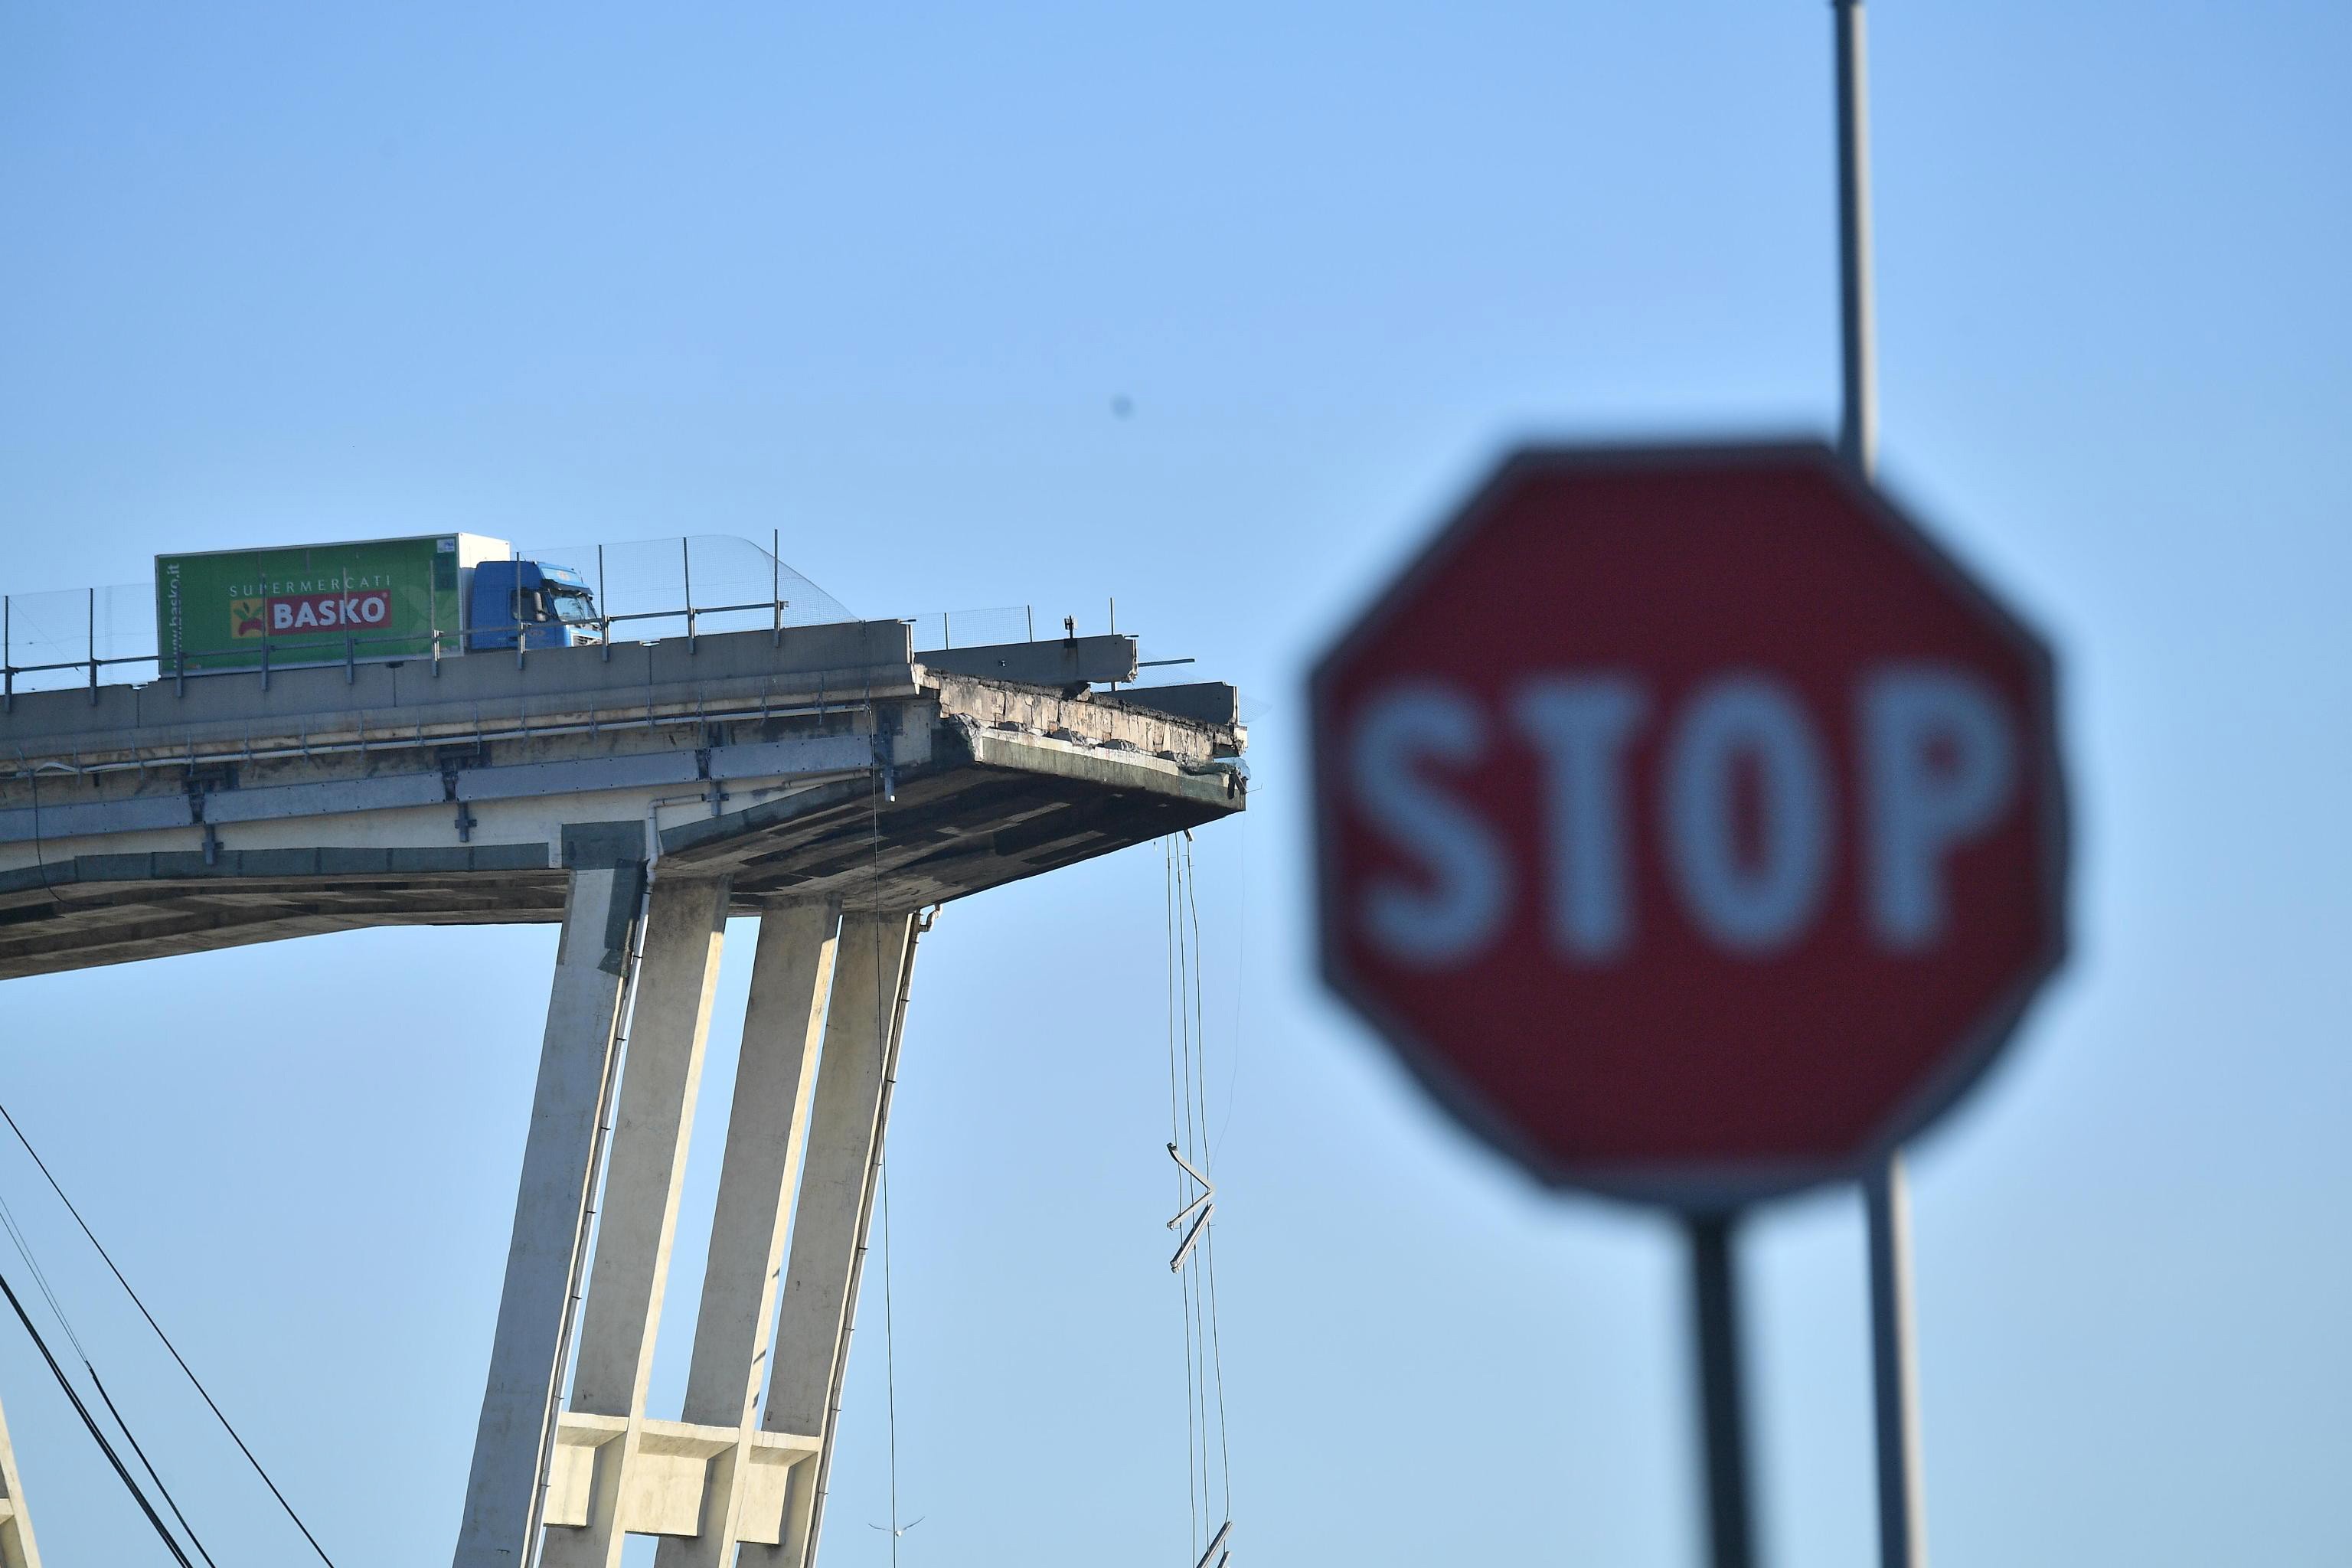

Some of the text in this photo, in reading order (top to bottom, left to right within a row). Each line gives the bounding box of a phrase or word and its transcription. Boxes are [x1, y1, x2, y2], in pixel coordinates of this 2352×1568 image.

[230, 575, 390, 597] SUPERMERCATI
[273, 596, 386, 629] BASKO
[1354, 671, 2015, 965] STOP
